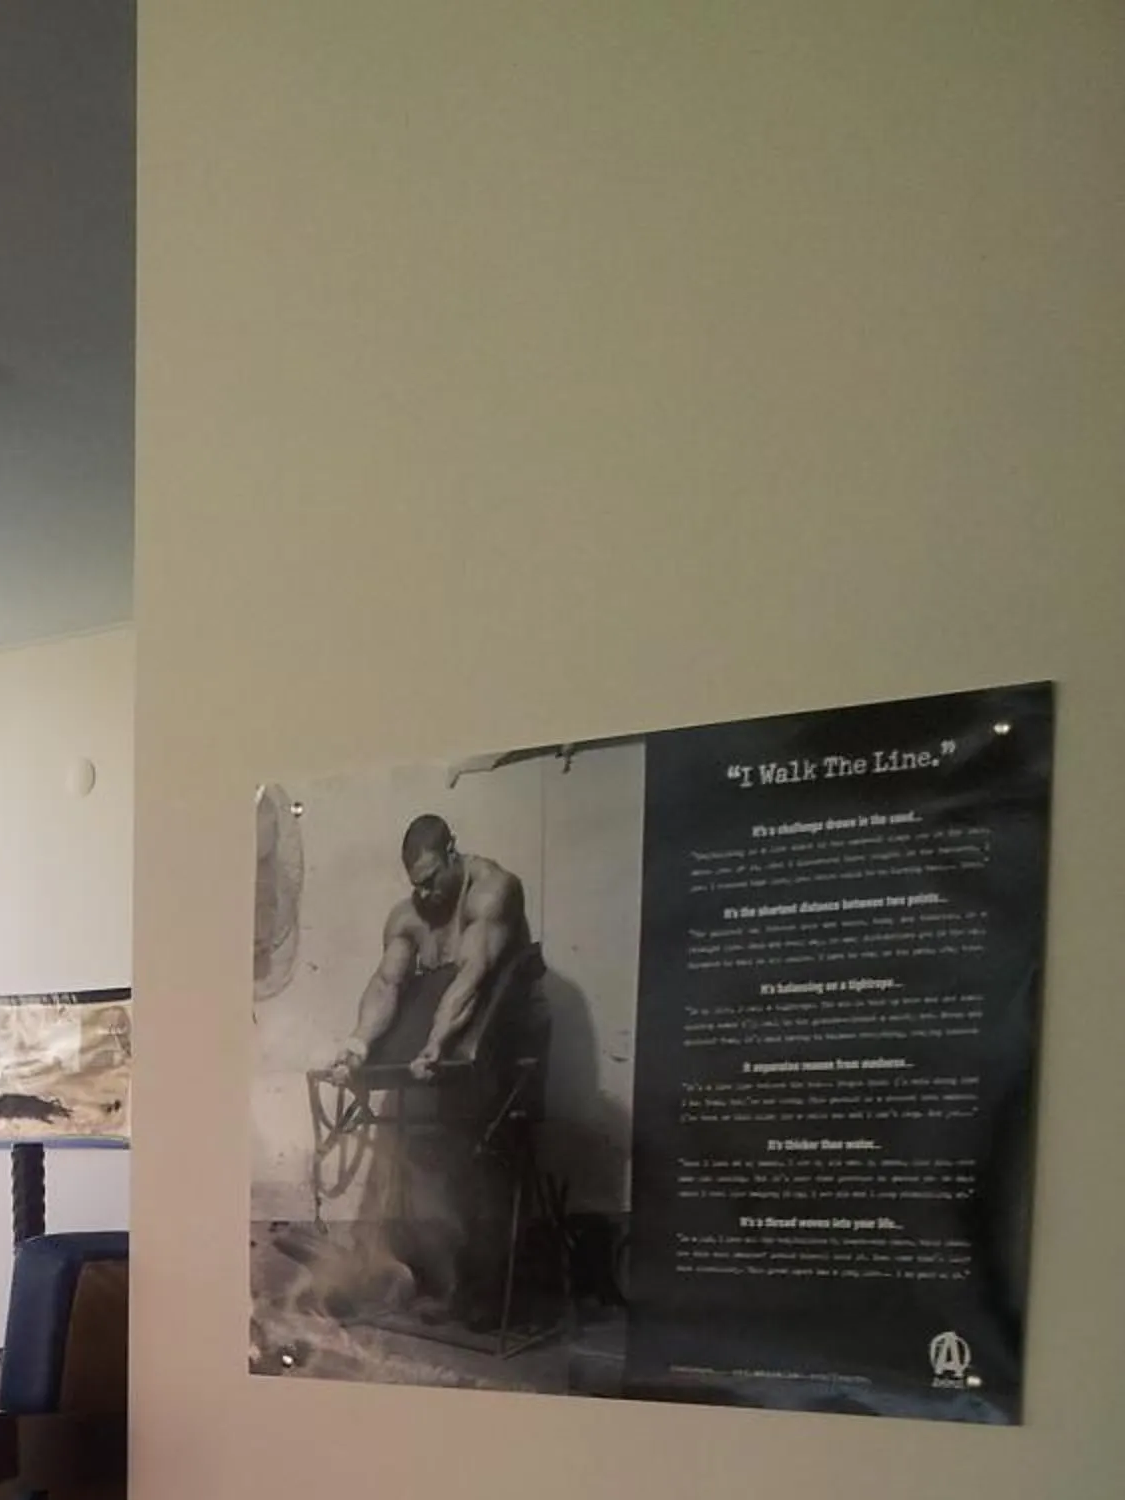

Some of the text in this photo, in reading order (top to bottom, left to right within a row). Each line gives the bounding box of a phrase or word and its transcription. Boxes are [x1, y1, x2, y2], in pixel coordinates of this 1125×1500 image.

[727, 739, 956, 788] “I Walk The Line.”
[870, 813, 886, 825] the
[740, 905, 756, 918] the
[758, 903, 797, 916] shortest
[799, 901, 840, 913] distance
[842, 898, 883, 910] between
[886, 896, 905, 906] two
[836, 1058, 860, 1069] from
